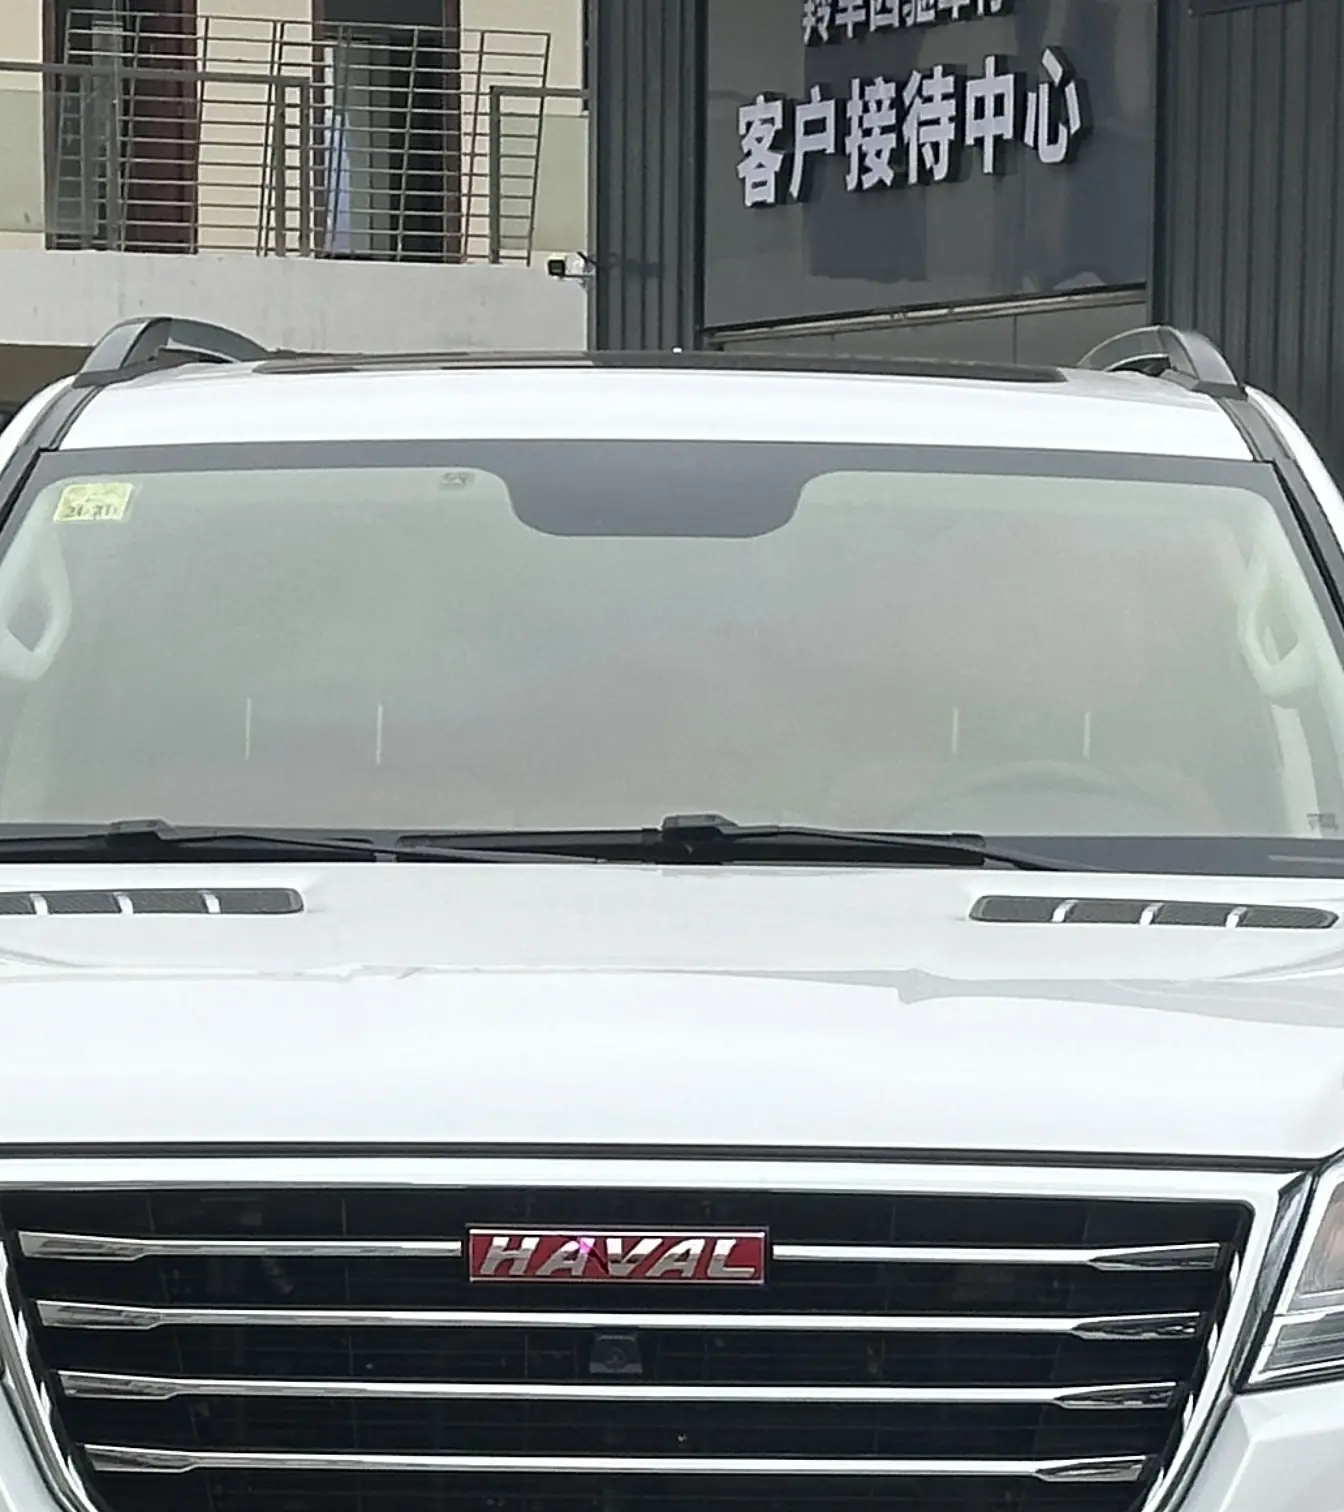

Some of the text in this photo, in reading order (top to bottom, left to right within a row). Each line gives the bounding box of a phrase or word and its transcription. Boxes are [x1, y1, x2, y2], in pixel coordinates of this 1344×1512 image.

[737, 47, 1081, 207] 客户接待中心
[479, 1235, 756, 1278] HAVAL
